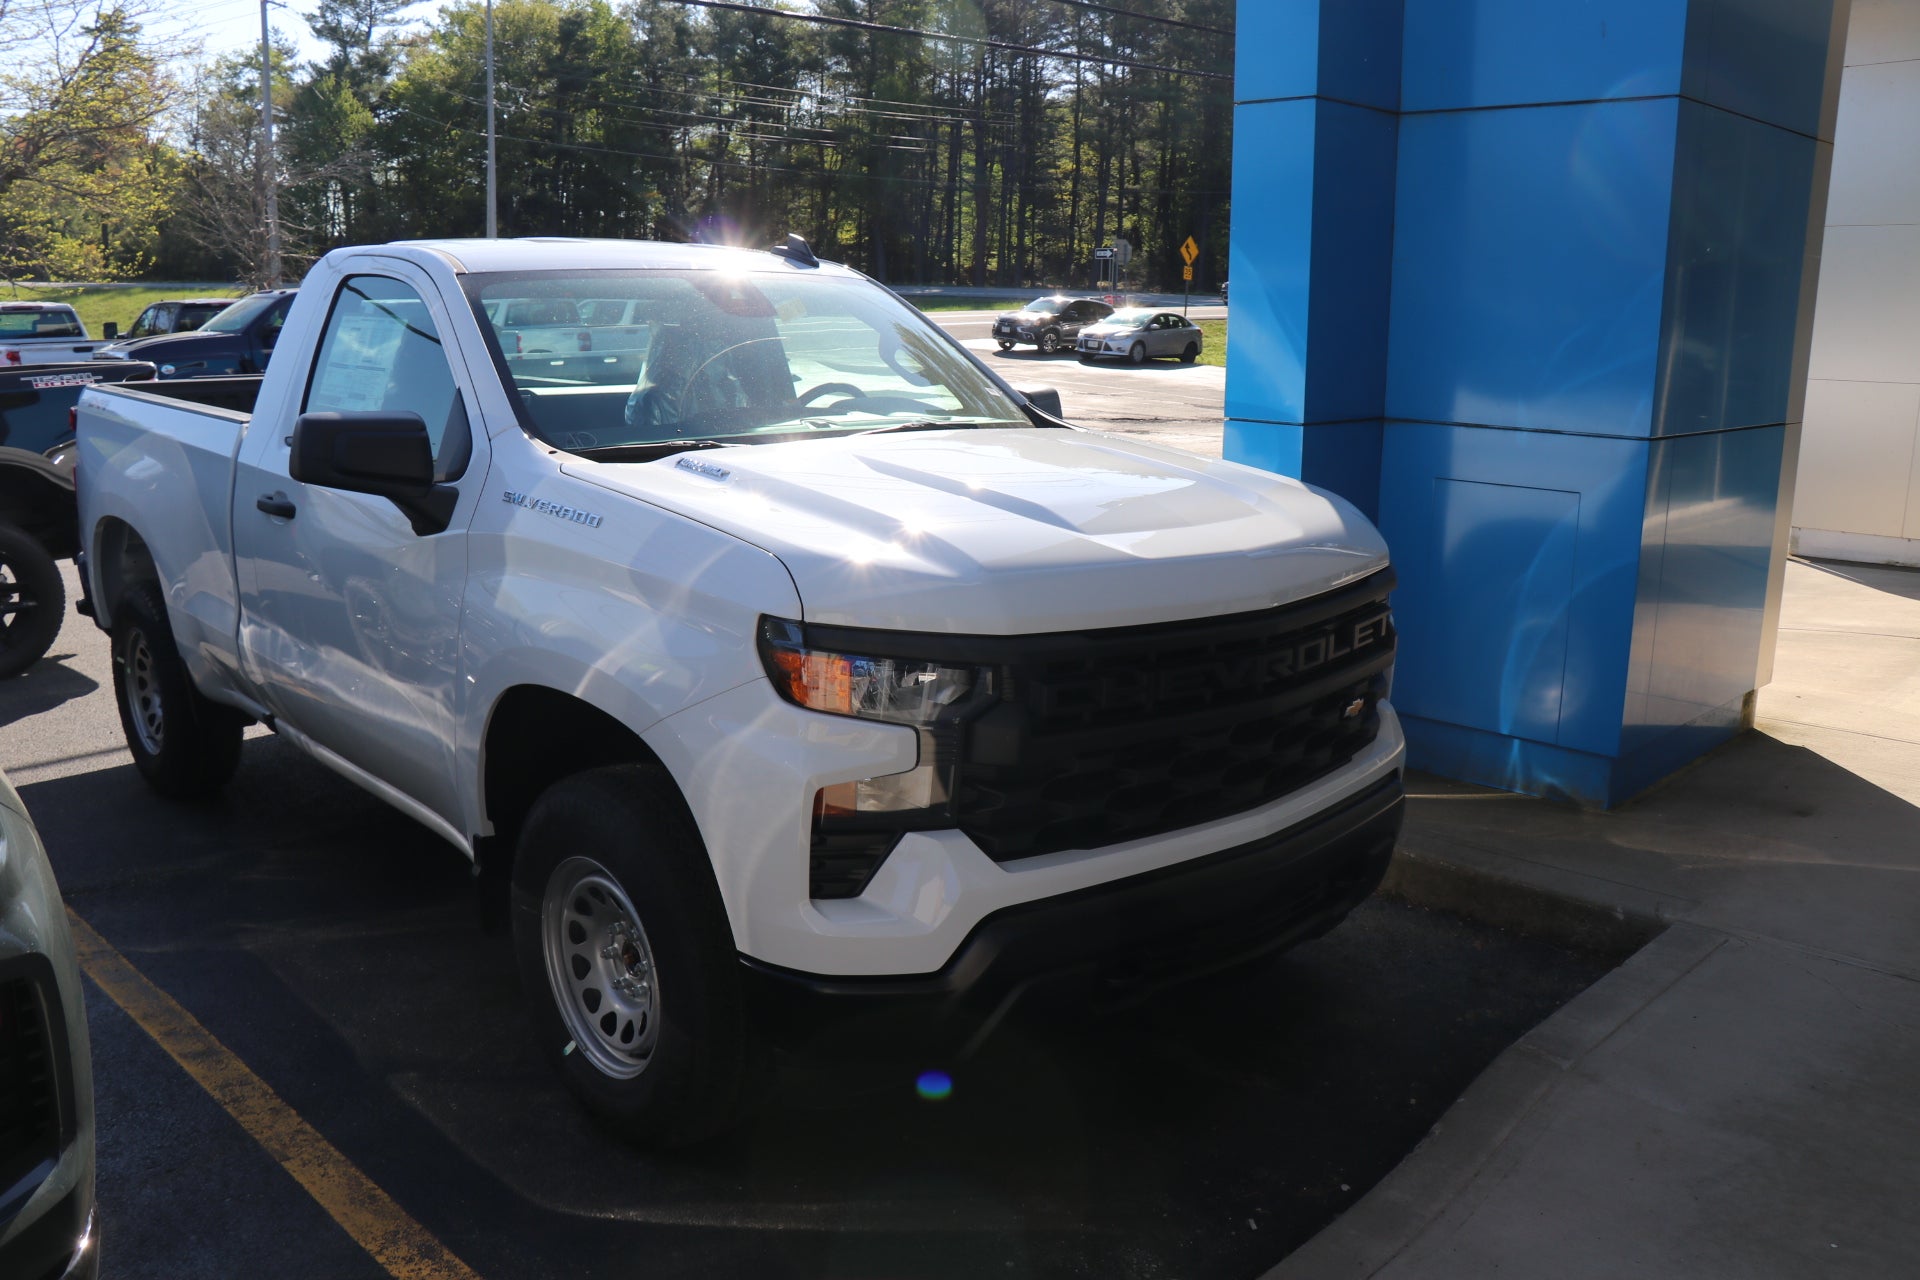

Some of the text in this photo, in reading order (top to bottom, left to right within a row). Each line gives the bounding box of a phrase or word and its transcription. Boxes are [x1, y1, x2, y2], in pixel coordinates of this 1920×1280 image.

[20, 372, 103, 384] TRAIL
[32, 379, 95, 389] BOSS
[502, 490, 603, 528] SILVERADO
